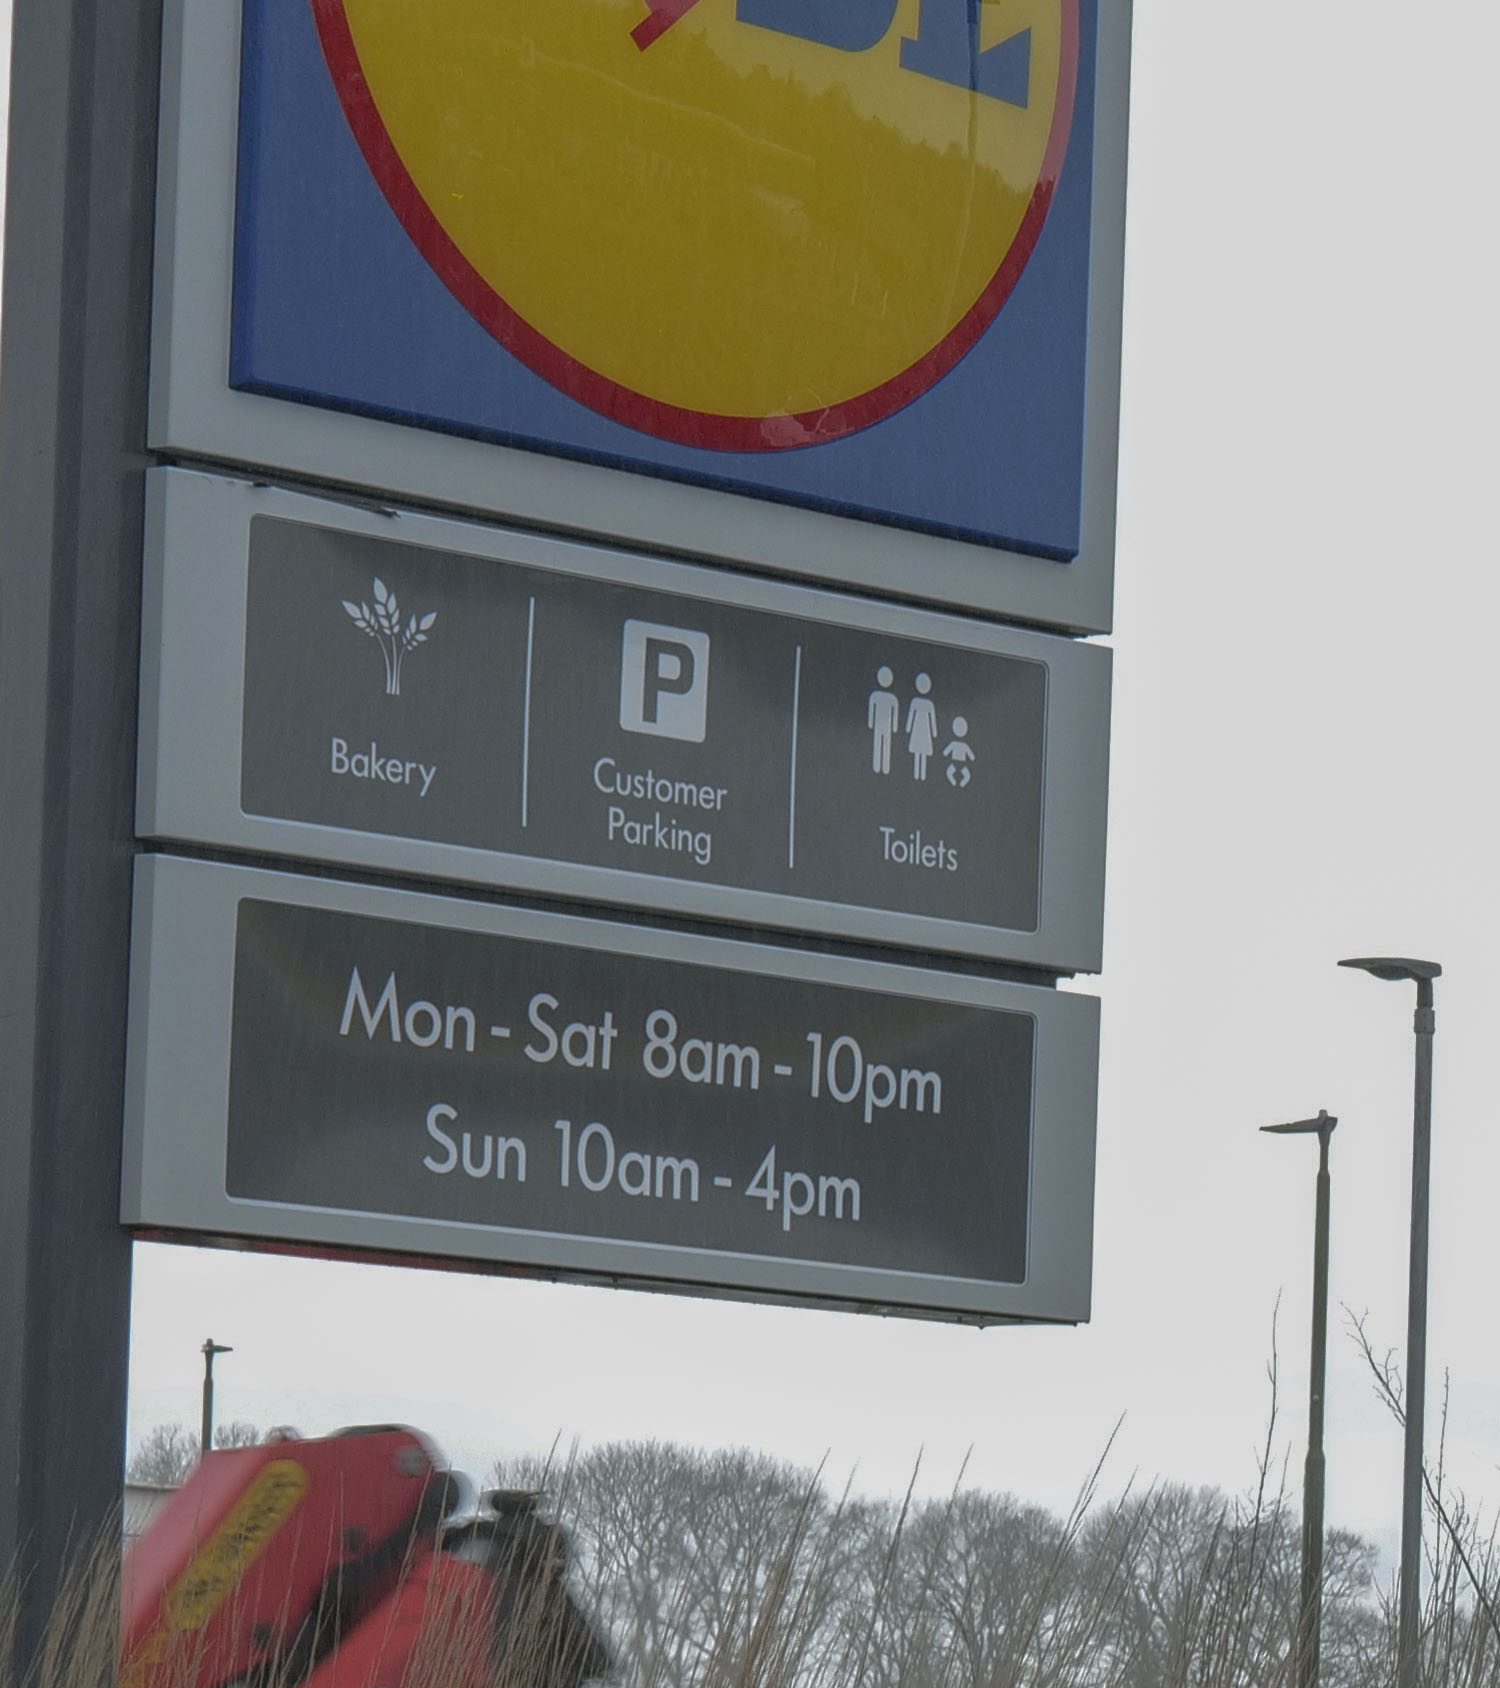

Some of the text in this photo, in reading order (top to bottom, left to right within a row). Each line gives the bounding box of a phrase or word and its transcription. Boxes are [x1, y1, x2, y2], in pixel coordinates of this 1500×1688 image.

[641, 636, 695, 724] P
[331, 737, 438, 797] Bakery
[593, 757, 728, 811] Customer
[608, 806, 712, 866] Parking
[879, 825, 959, 871] Toilets
[338, 965, 476, 1053] Mon
[522, 993, 619, 1071] Sat
[641, 1008, 761, 1091] 8am
[805, 1030, 943, 1124] 10pm
[422, 1102, 527, 1183] Sun
[553, 1118, 700, 1202] 10am
[744, 1143, 862, 1232] 4pm
